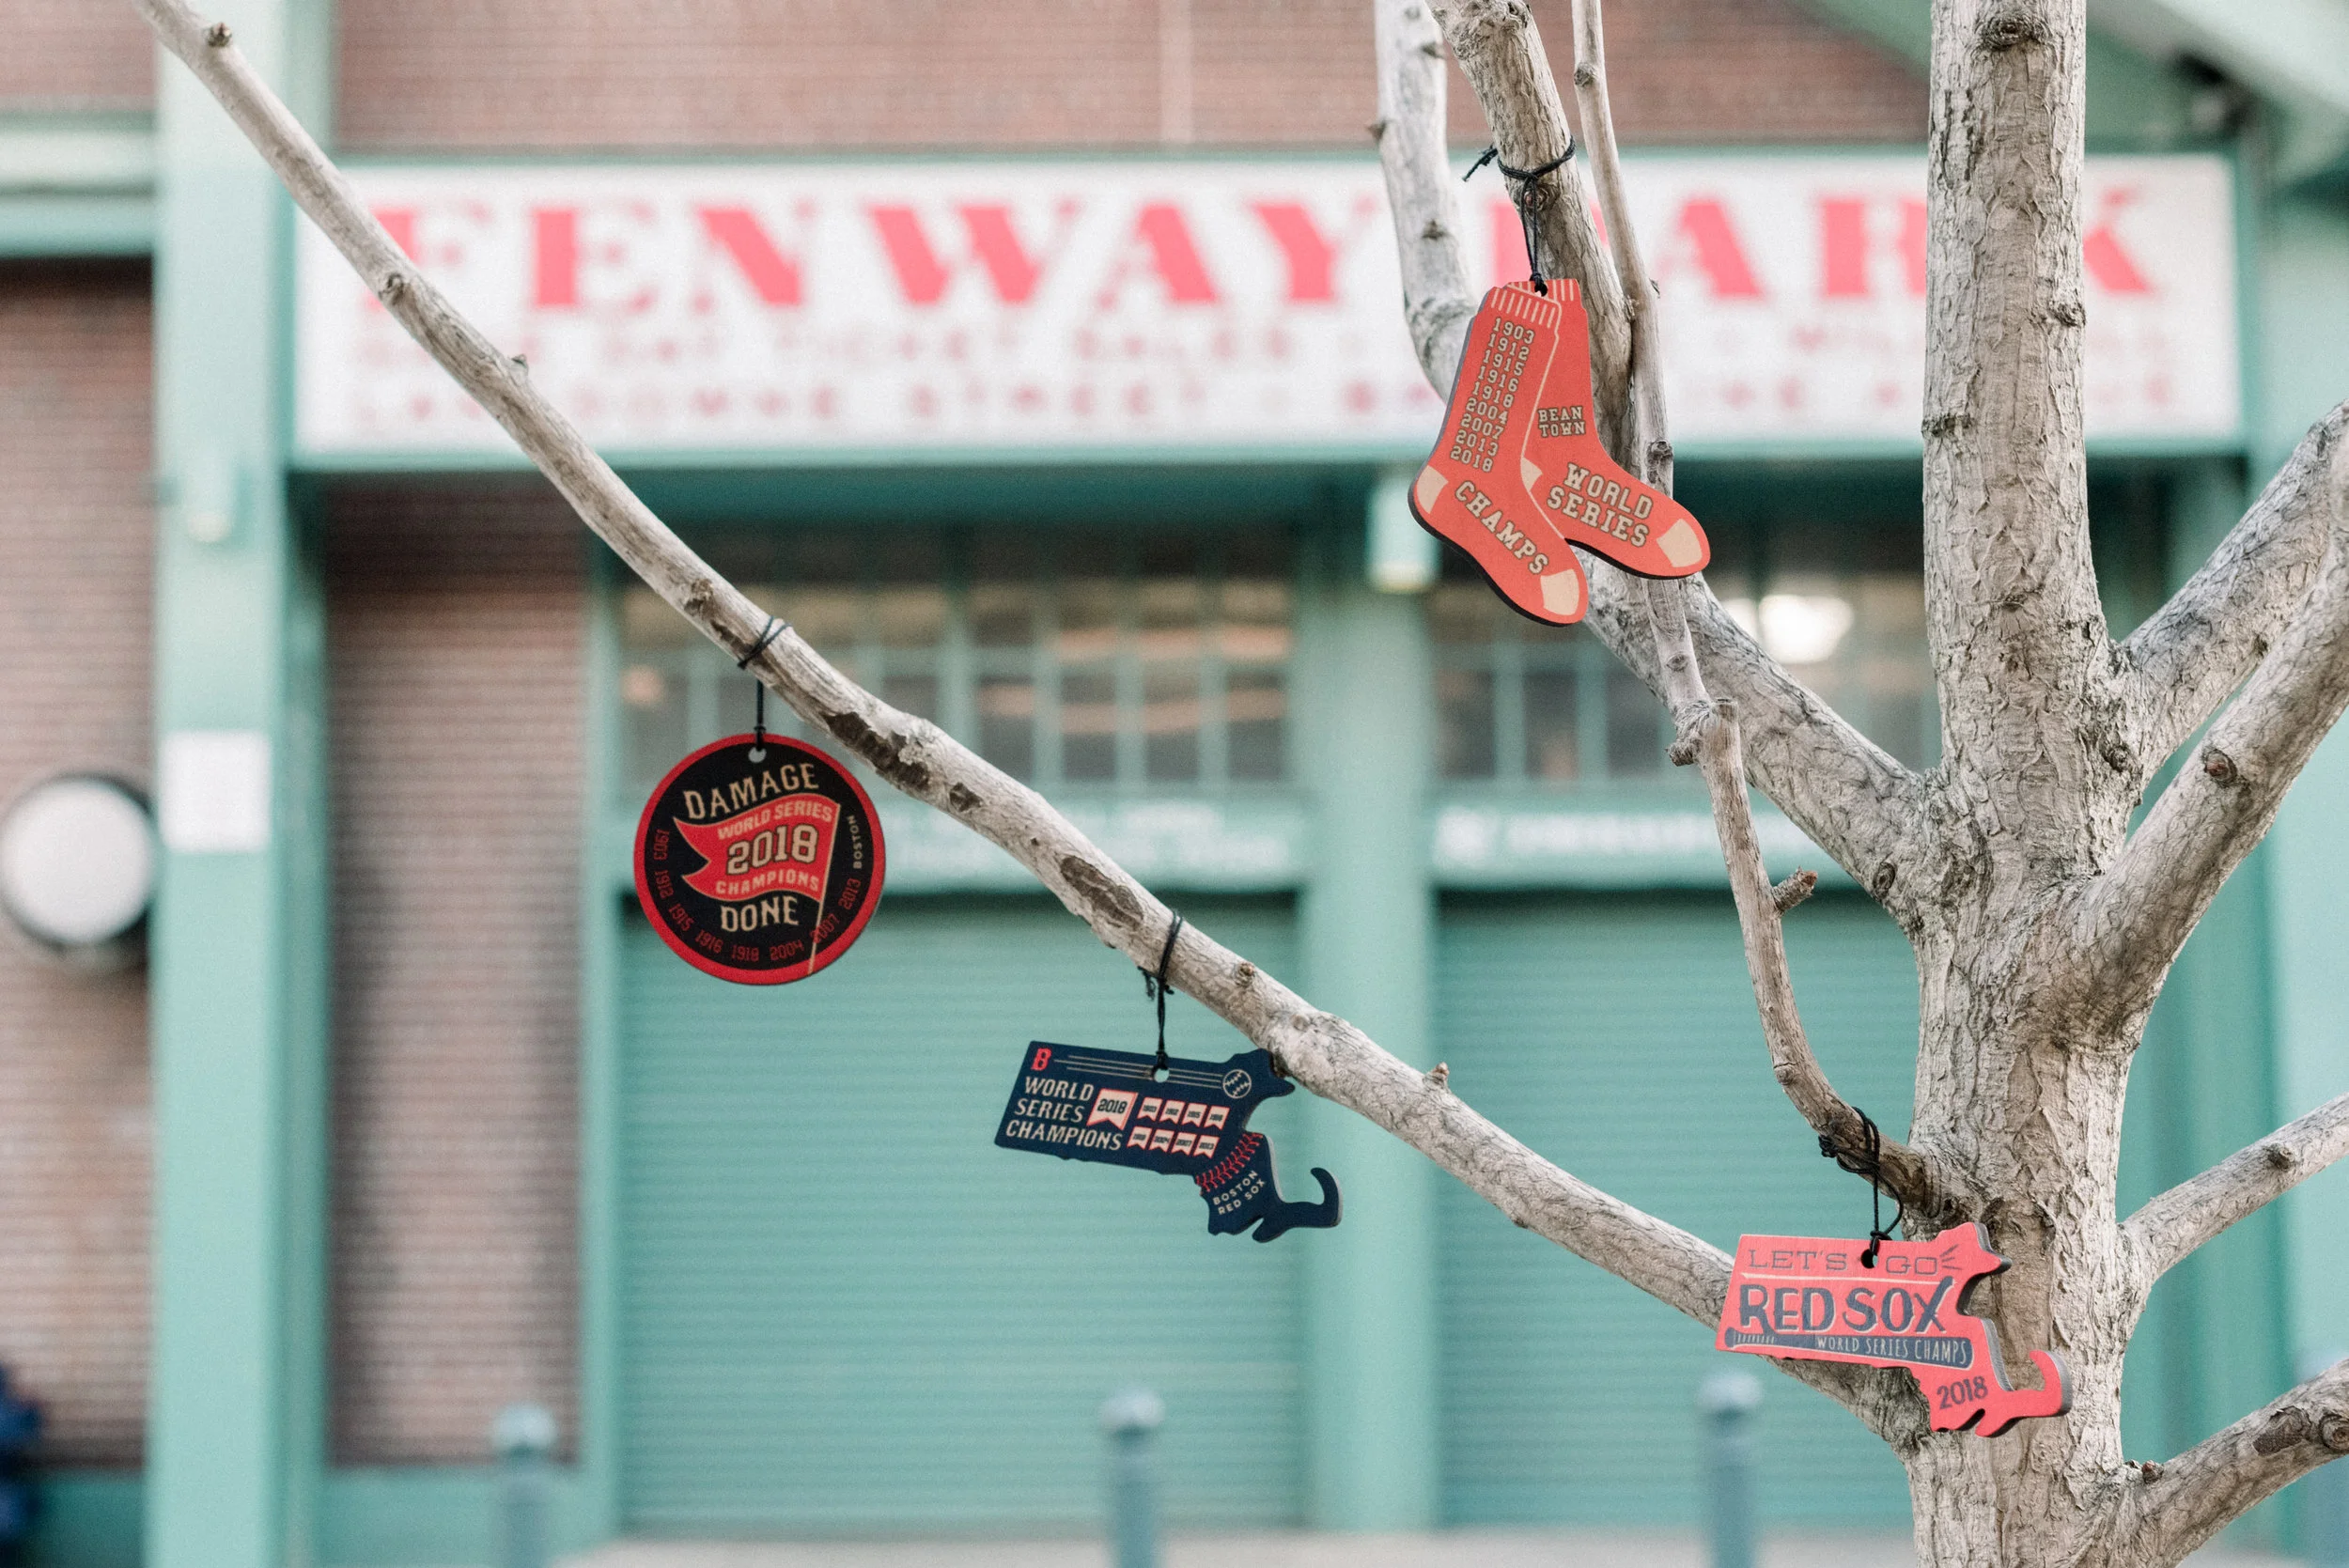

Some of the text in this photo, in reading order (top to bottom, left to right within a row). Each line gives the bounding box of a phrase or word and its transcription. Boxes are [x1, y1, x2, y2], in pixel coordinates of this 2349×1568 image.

[366, 198, 1379, 311] FENWAY
[1493, 318, 1535, 344] 1903
[1488, 334, 1530, 361] 1912
[1483, 349, 1525, 376] 1915
[1478, 366, 1518, 393] 1916
[1472, 381, 1514, 408] 1918
[1466, 398, 1508, 425] 2004
[1538, 406, 1583, 423] BEAN
[1460, 413, 1503, 440] 2007
[1538, 422, 1586, 438] TOWN
[1456, 430, 1499, 457] 2013
[1451, 445, 1493, 472] 2018
[1563, 462, 1653, 520] WORLD
[1455, 480, 1549, 575] CHAMPS
[1547, 486, 1650, 548] SERIES
[683, 763, 819, 819] DAMAGE
[718, 800, 832, 840] WORLD SERIES
[726, 823, 819, 876] 2018
[848, 815, 863, 869] BOSTON
[716, 869, 819, 894] CHAMPIONS
[655, 870, 674, 899] 1912
[669, 904, 694, 932] 1915
[769, 939, 804, 961] 2004
[838, 877, 861, 909] 2013
[721, 895, 799, 932] DONE
[1031, 1048, 1052, 1071] B
[1025, 1076, 1094, 1101] WORLD
[1015, 1098, 1085, 1124] SERIES
[1097, 1099, 1128, 1114] 2018
[1005, 1120, 1123, 1151] CHAMPIONS
[1213, 1171, 1257, 1204] BOSTON
[1218, 1178, 1265, 1215] RED SOX
[1748, 1249, 1938, 1275] LET'S GO
[1739, 1276, 1955, 1334] RED SOX
[1816, 1336, 1968, 1365] WORLD SERIES CHAMPS
[1937, 1376, 1988, 1409] 2018
